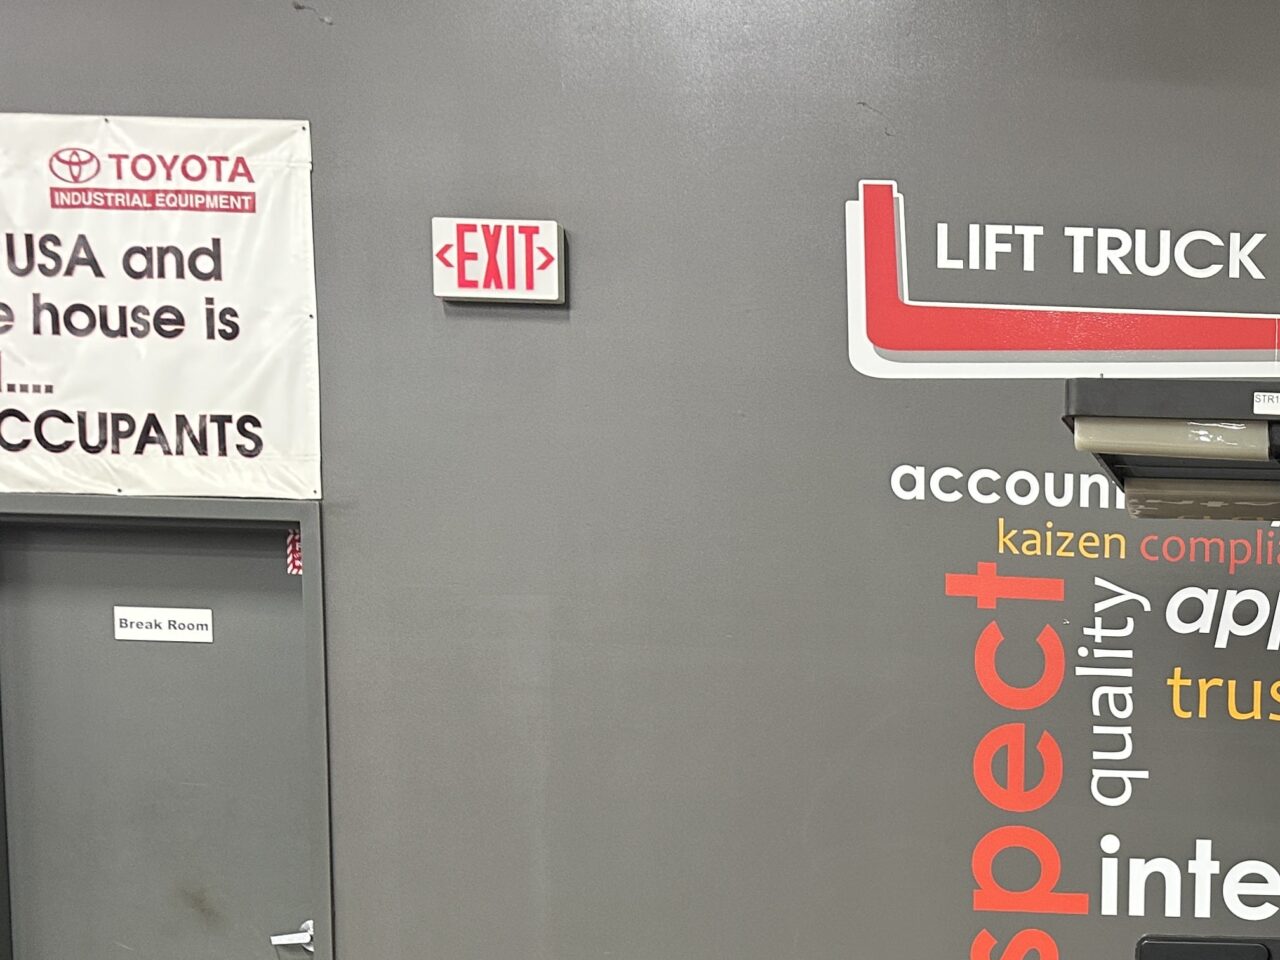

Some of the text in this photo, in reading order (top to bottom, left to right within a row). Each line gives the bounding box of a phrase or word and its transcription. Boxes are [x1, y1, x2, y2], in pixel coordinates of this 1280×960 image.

[108, 154, 254, 183] TOYOTA
[54, 191, 252, 210] INDUSTRIAL EQUIPMENT
[6, 232, 222, 281] USA and
[456, 223, 539, 291] EXIT
[937, 223, 1044, 271] LIFT
[1064, 226, 1267, 279] TRUCK
[32, 293, 186, 338] house
[205, 297, 240, 340] is
[997, 518, 1126, 560] kaizen
[119, 618, 209, 631] Break Room
[1075, 577, 1152, 807] quality
